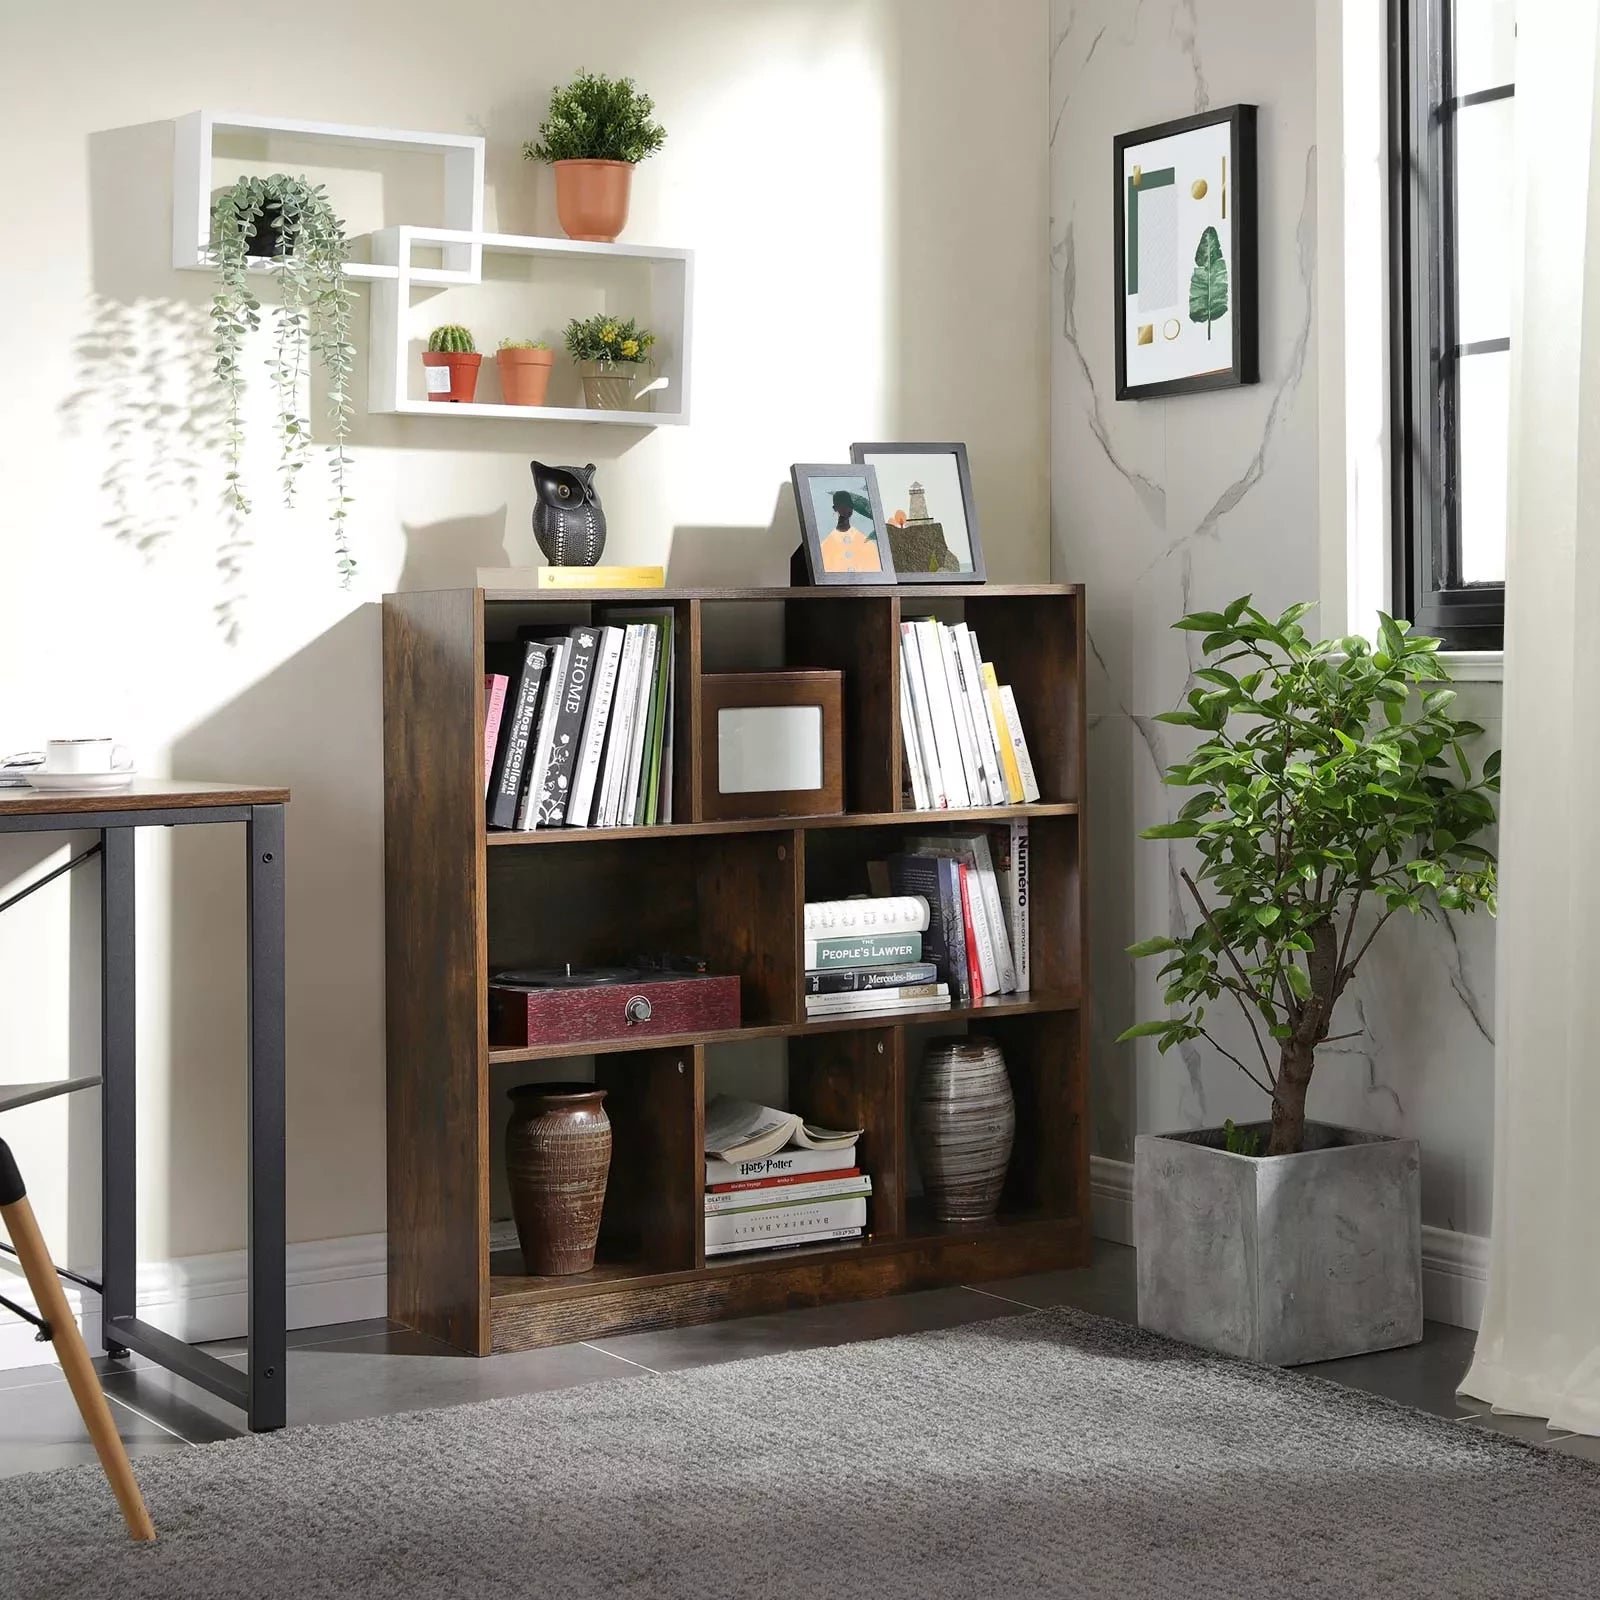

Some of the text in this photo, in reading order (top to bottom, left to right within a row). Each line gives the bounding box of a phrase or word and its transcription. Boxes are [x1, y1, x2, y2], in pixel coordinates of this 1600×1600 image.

[564, 654, 588, 714] HOME
[506, 680, 539, 796] The Most Excellent
[1018, 836, 1028, 906] Numéro
[822, 944, 912, 959] PEOPLE'S LAWYER
[868, 971, 923, 984] Mercedes-Benz
[741, 1158, 793, 1175] Harry Potter
